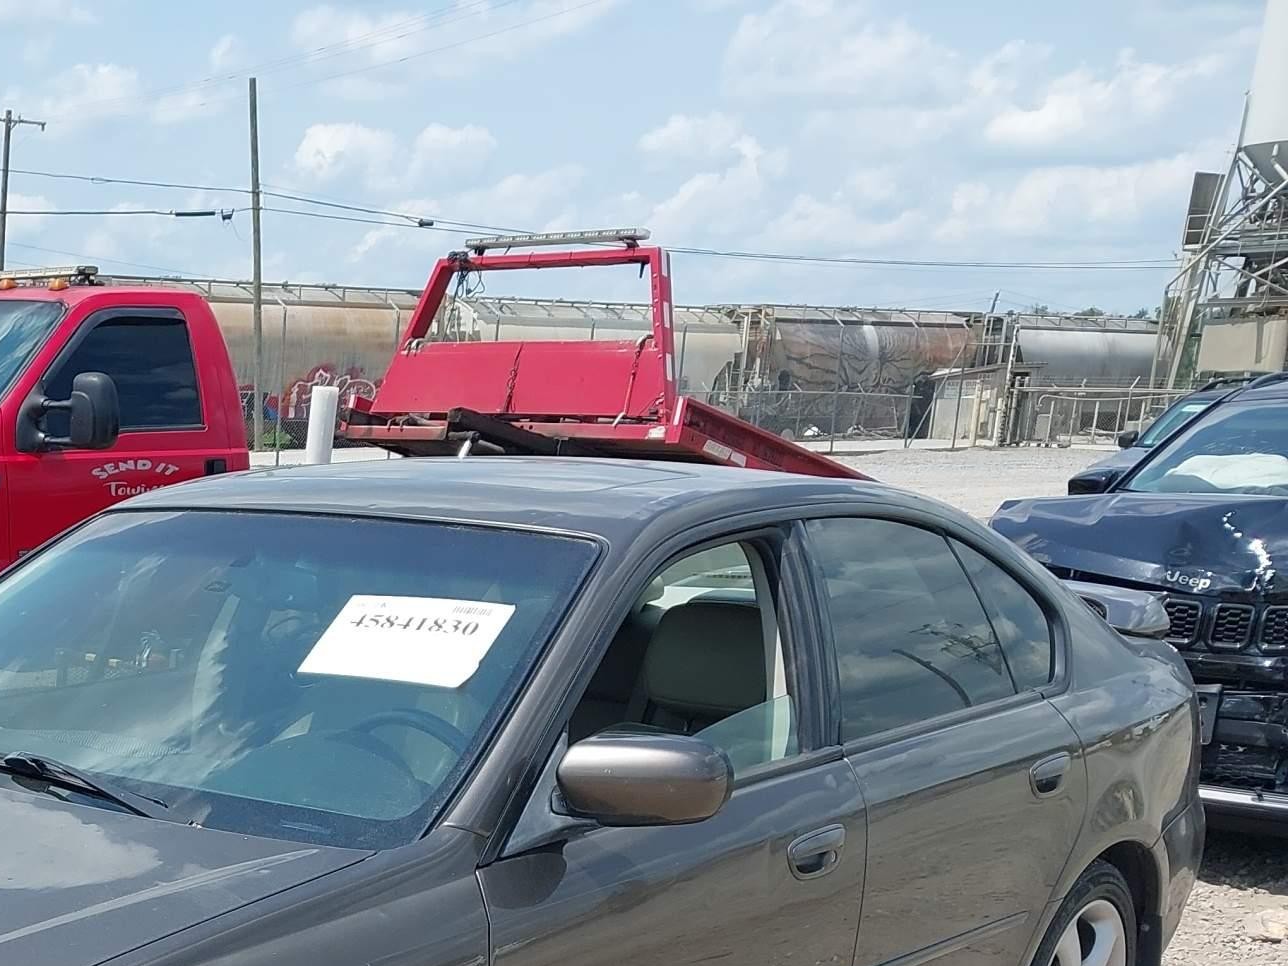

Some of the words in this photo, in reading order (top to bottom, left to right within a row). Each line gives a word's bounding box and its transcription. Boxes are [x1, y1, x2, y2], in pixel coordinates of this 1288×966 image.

[91, 459, 153, 479] SEND
[155, 462, 180, 476] IT
[1166, 570, 1211, 590] Jeep
[350, 613, 480, 636] 45841830
